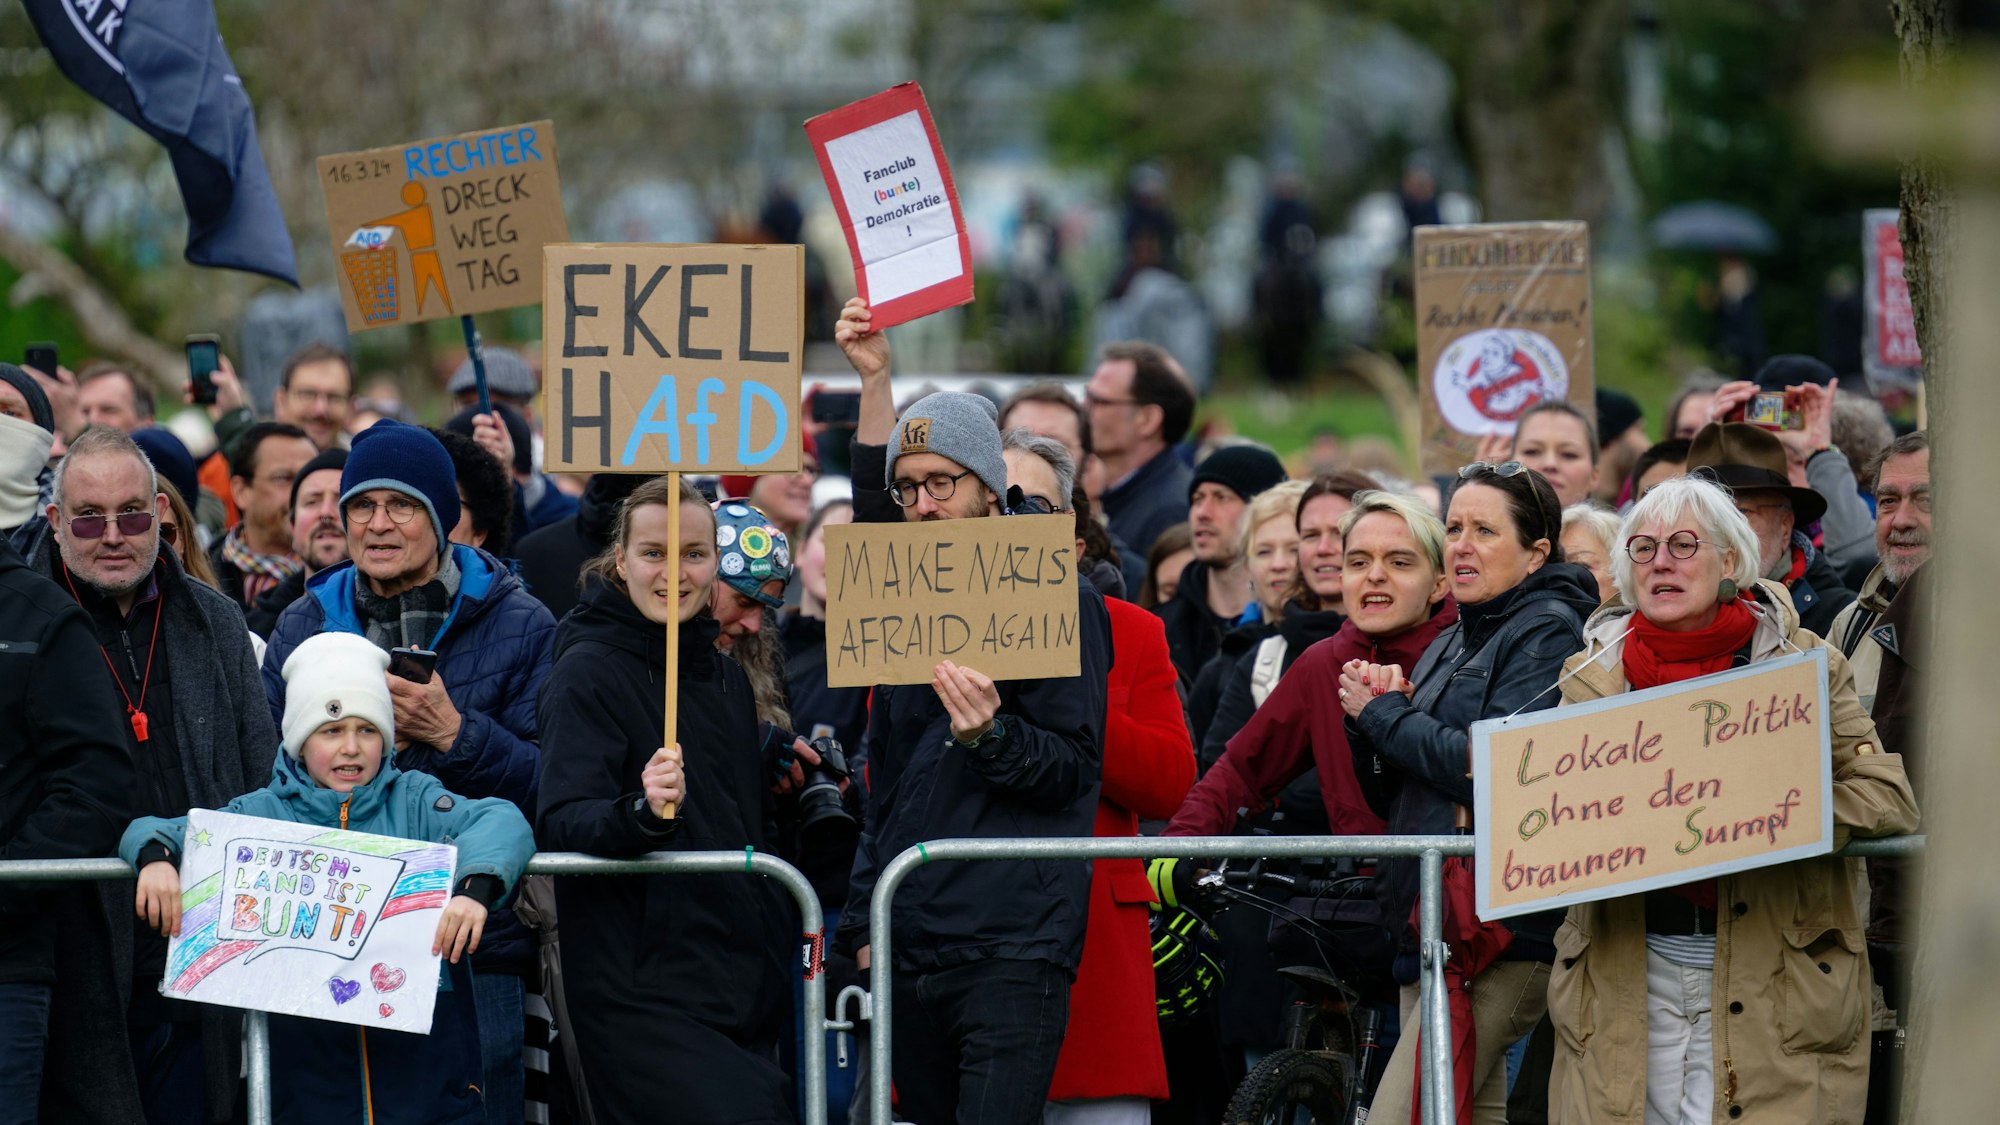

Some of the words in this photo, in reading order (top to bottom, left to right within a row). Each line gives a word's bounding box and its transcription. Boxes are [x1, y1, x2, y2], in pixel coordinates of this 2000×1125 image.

[327, 158, 392, 184] 16.3.24
[403, 126, 543, 182] RECHTER
[863, 155, 917, 183] Fanclub
[440, 172, 532, 215] DRECK
[865, 194, 941, 229] Demokratie
[873, 176, 921, 206] (bunte)
[449, 213, 520, 251] WEG
[905, 224, 912, 237] !
[455, 253, 521, 292] TAG
[562, 263, 790, 363] EKEL
[561, 367, 789, 468] HAfD
[838, 540, 955, 602] MAKE
[967, 541, 1071, 595] NAZIS
[837, 612, 972, 668] AFRAID
[981, 611, 1078, 655] AGAIN
[1517, 719, 1665, 788] Lokale
[1688, 693, 1813, 748] Politik
[1647, 767, 1723, 810] den
[1502, 845, 1647, 893] braunen
[1674, 786, 1802, 856] Sumpf
[235, 845, 362, 880] DEUTSCH-
[234, 866, 316, 897] LAND
[323, 877, 372, 905] IST
[230, 893, 368, 948] BUNT!
